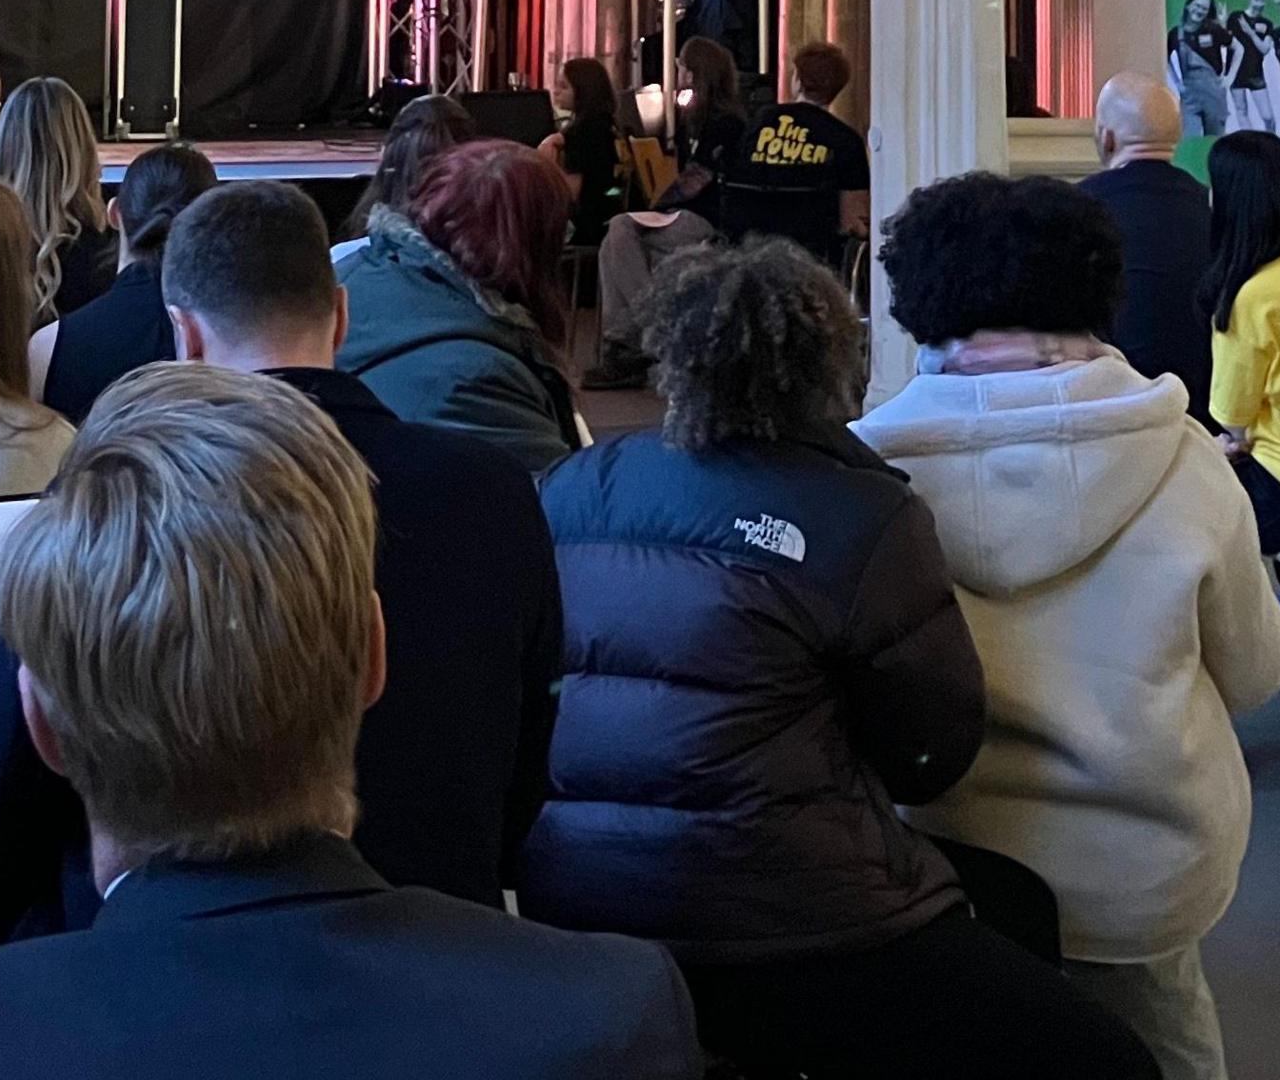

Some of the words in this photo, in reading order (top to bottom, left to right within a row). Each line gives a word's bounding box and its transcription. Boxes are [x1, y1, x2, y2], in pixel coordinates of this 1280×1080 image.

[777, 114, 809, 142] THE
[756, 126, 829, 165] POWER
[733, 518, 783, 541] NORTH
[760, 513, 788, 528] THE
[744, 530, 781, 553] FACE
